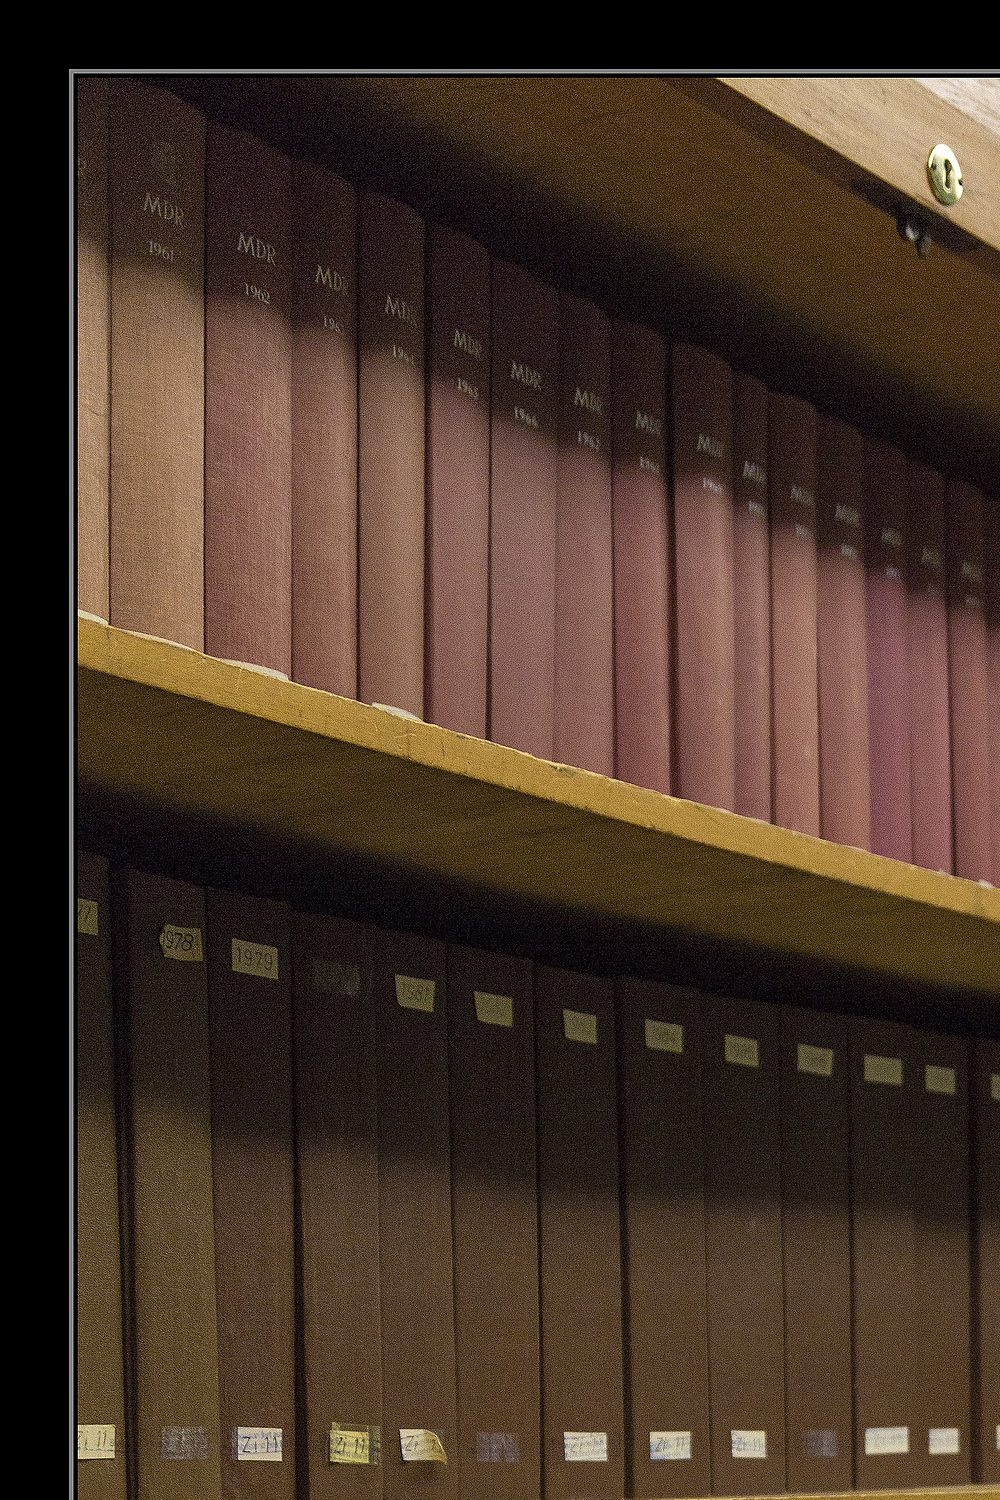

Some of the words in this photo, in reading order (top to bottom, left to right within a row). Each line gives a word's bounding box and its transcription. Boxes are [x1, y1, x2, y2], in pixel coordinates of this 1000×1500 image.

[143, 192, 184, 229] MDR
[148, 239, 175, 262] 1961
[236, 232, 277, 267] MDR
[244, 282, 271, 305] 1962
[322, 315, 346, 335] 196
[235, 946, 274, 971] 1979
